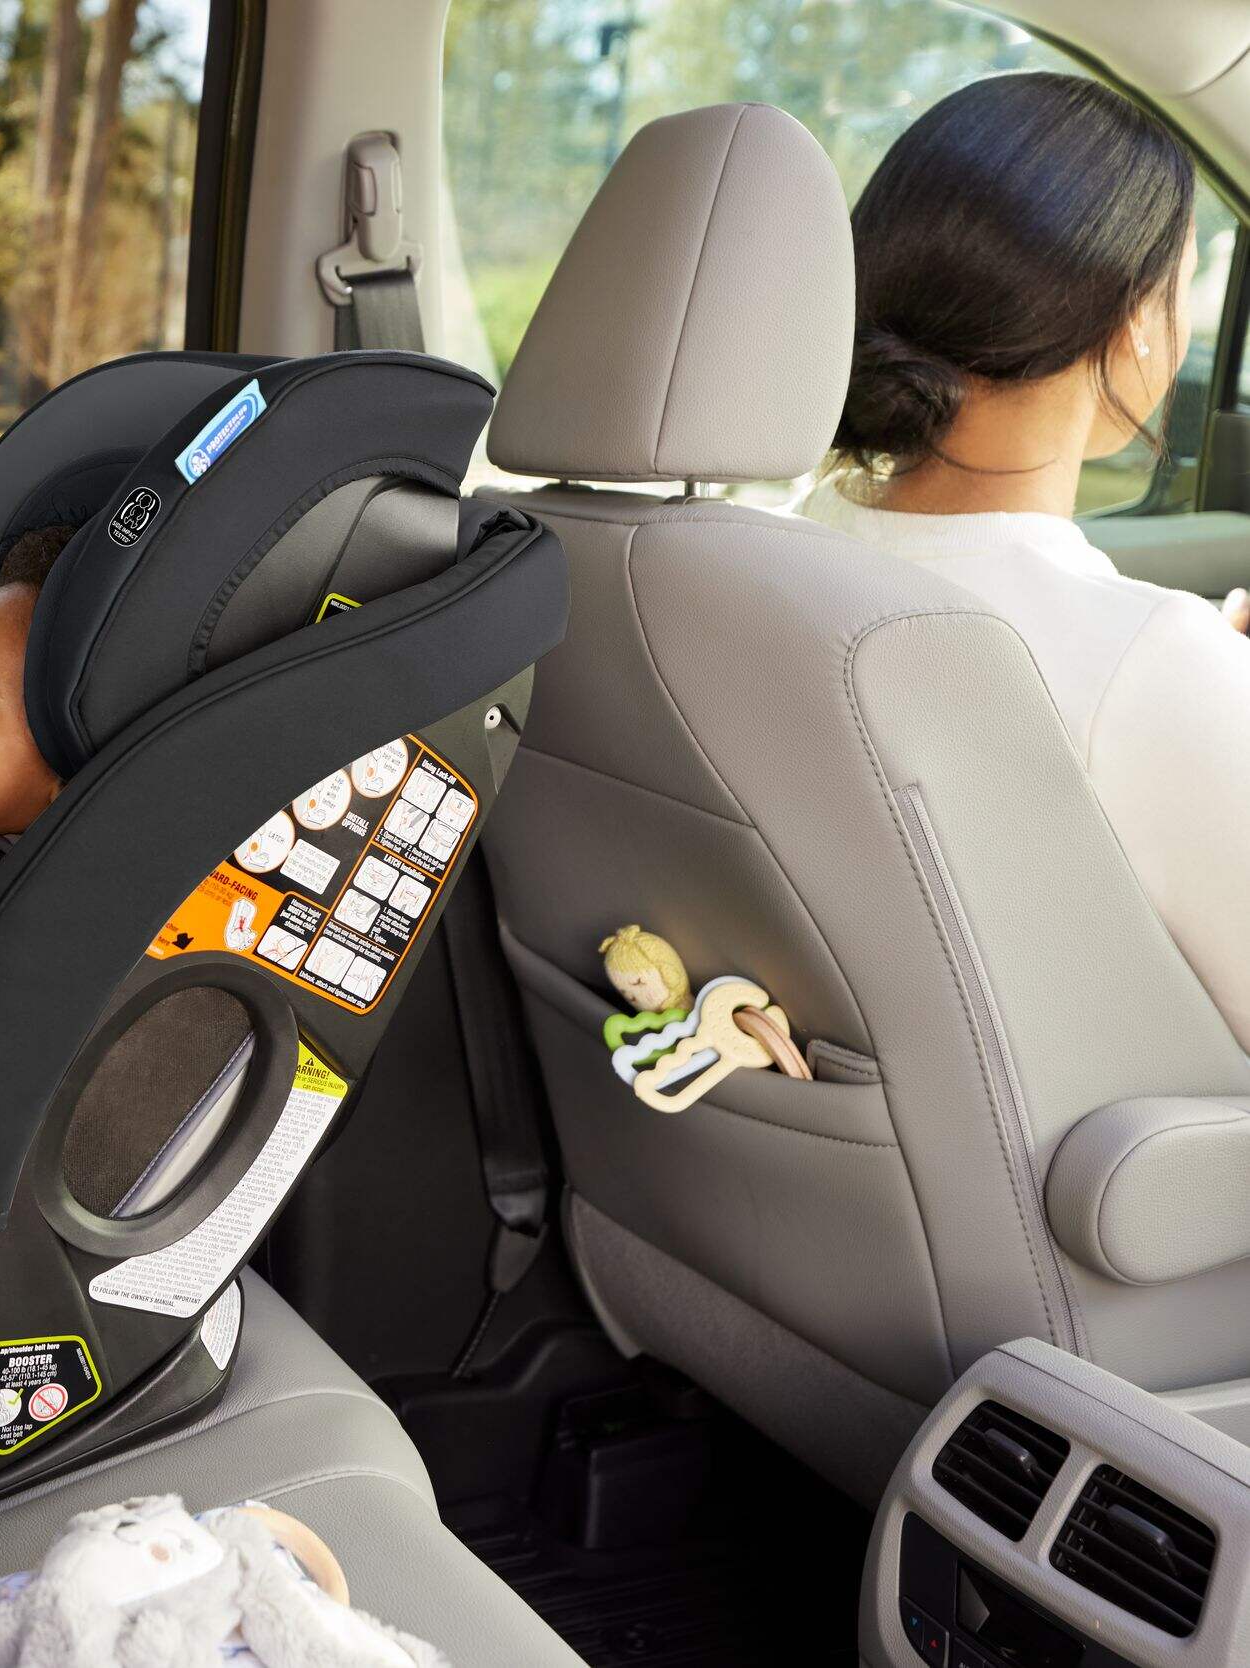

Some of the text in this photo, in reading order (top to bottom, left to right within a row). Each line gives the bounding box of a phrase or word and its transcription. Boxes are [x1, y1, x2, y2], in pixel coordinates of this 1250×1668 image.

[112, 520, 138, 540] SIDE IMPACT
[422, 759, 437, 774] Using
[345, 811, 369, 829] INSTALL
[342, 818, 367, 837] OPTIONS
[383, 854, 402, 868] LATCH
[296, 1065, 330, 1079] ARNING!
[307, 1078, 327, 1086] SERIOUS
[327, 1082, 344, 1090] INJURY
[99, 1288, 119, 1296] FOLLOW
[173, 1295, 200, 1304] IMPORTANT
[9, 1354, 52, 1367] BOOSTER
[13, 1425, 24, 1433] Use
[25, 1424, 33, 1432] lap
[5, 1438, 17, 1446] only
